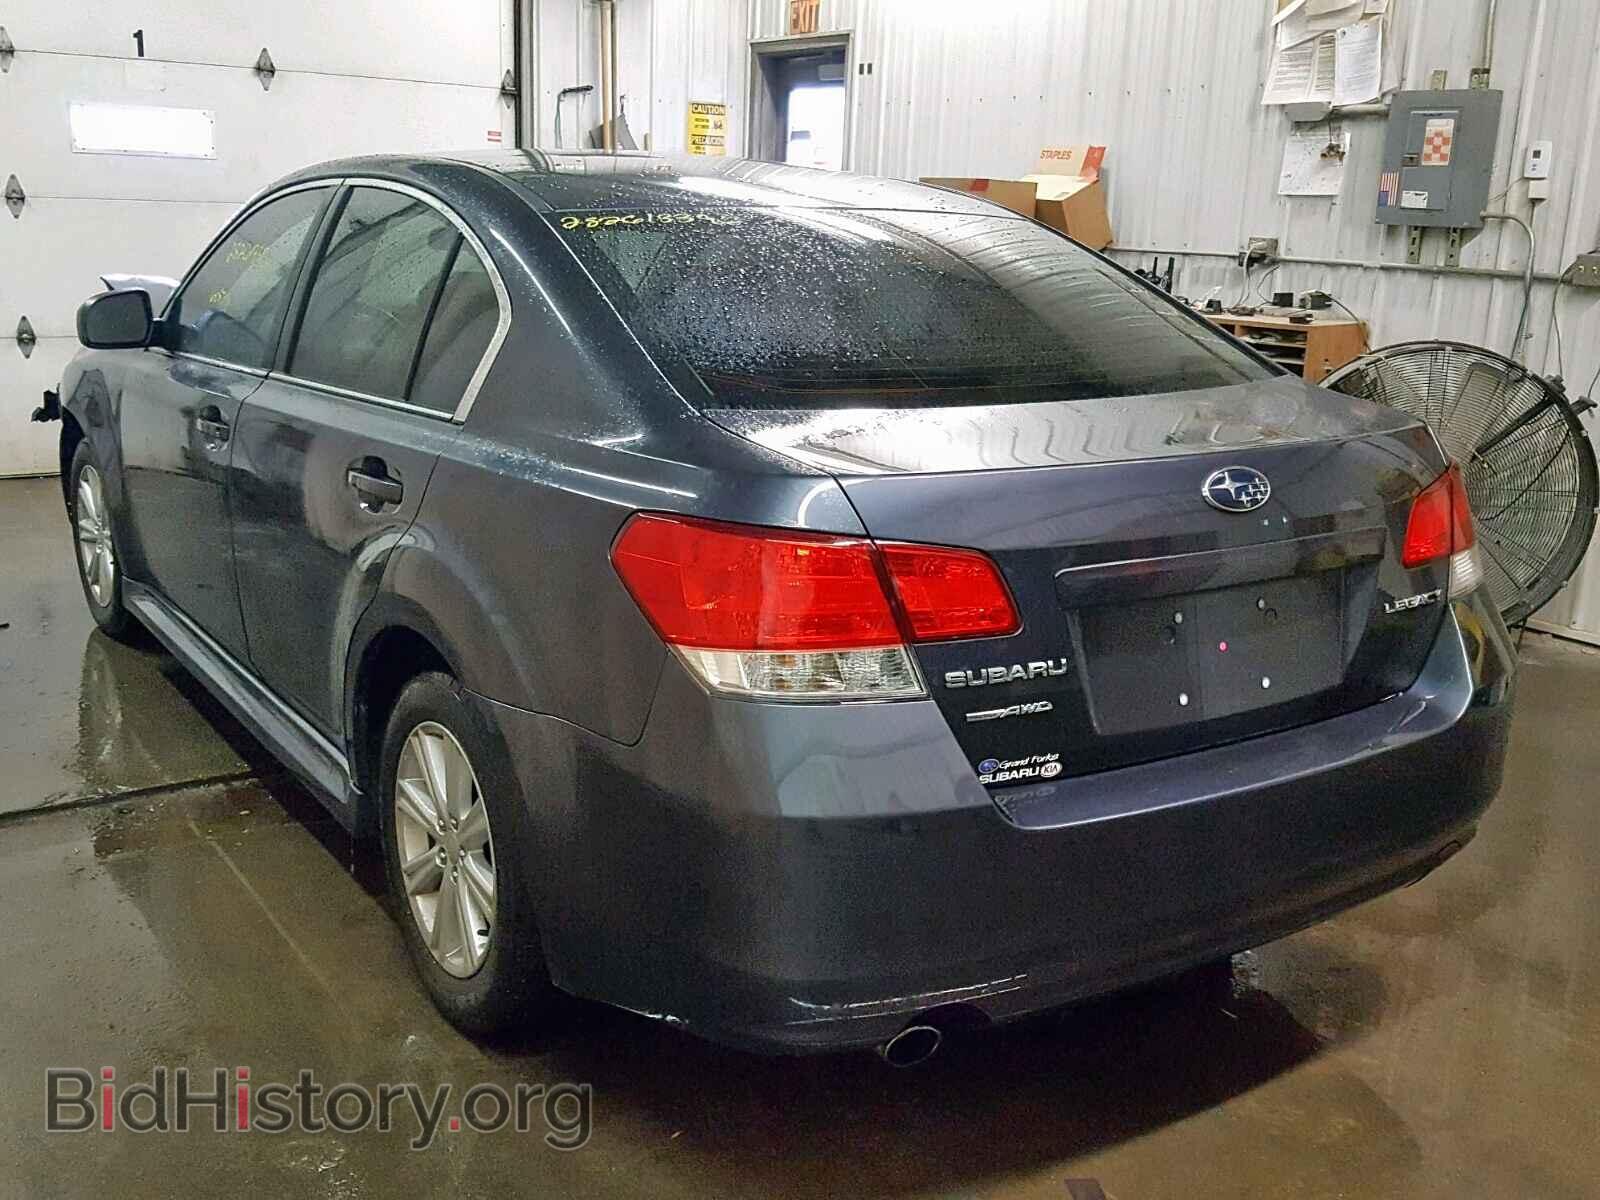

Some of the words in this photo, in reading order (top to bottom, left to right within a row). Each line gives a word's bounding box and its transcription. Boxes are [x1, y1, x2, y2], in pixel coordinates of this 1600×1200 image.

[132, 29, 145, 57] 1
[692, 104, 725, 115] CAUTION
[1040, 150, 1072, 161] STAPLES
[945, 658, 1067, 688] SUBARU
[1001, 701, 1053, 718] AWD
[1000, 757, 1030, 770] Grand
[1031, 753, 1060, 764] Forks
[980, 767, 1040, 784] SUBARU
